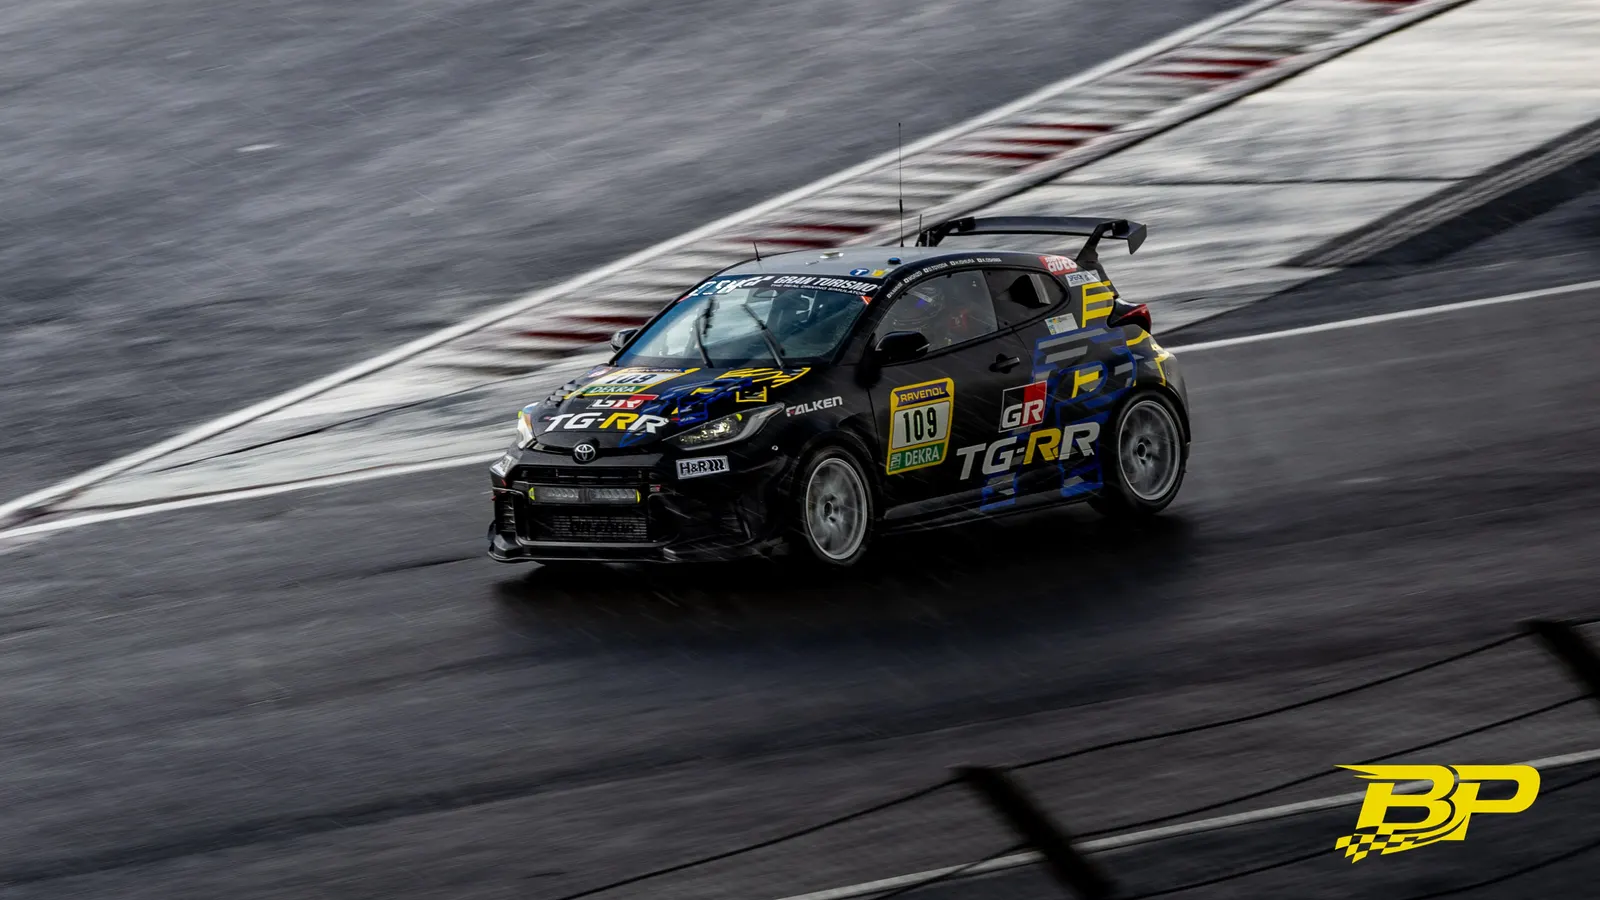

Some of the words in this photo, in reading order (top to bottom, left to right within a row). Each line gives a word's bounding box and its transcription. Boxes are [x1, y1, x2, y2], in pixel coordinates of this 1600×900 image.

[773, 275, 815, 286] GRAN
[815, 277, 877, 293] TURISMO
[828, 287, 867, 297] SIMULATOR
[606, 373, 657, 384] 109
[591, 385, 635, 394] DEKRA
[900, 387, 946, 403] RAVENOL
[785, 395, 843, 417] FALKEN
[1001, 399, 1045, 429] GR
[544, 412, 669, 435] TG-RR
[902, 406, 938, 444] 109
[904, 445, 941, 467] DEKRA
[956, 421, 1101, 481] TG-RR
[679, 462, 708, 477] H&R
